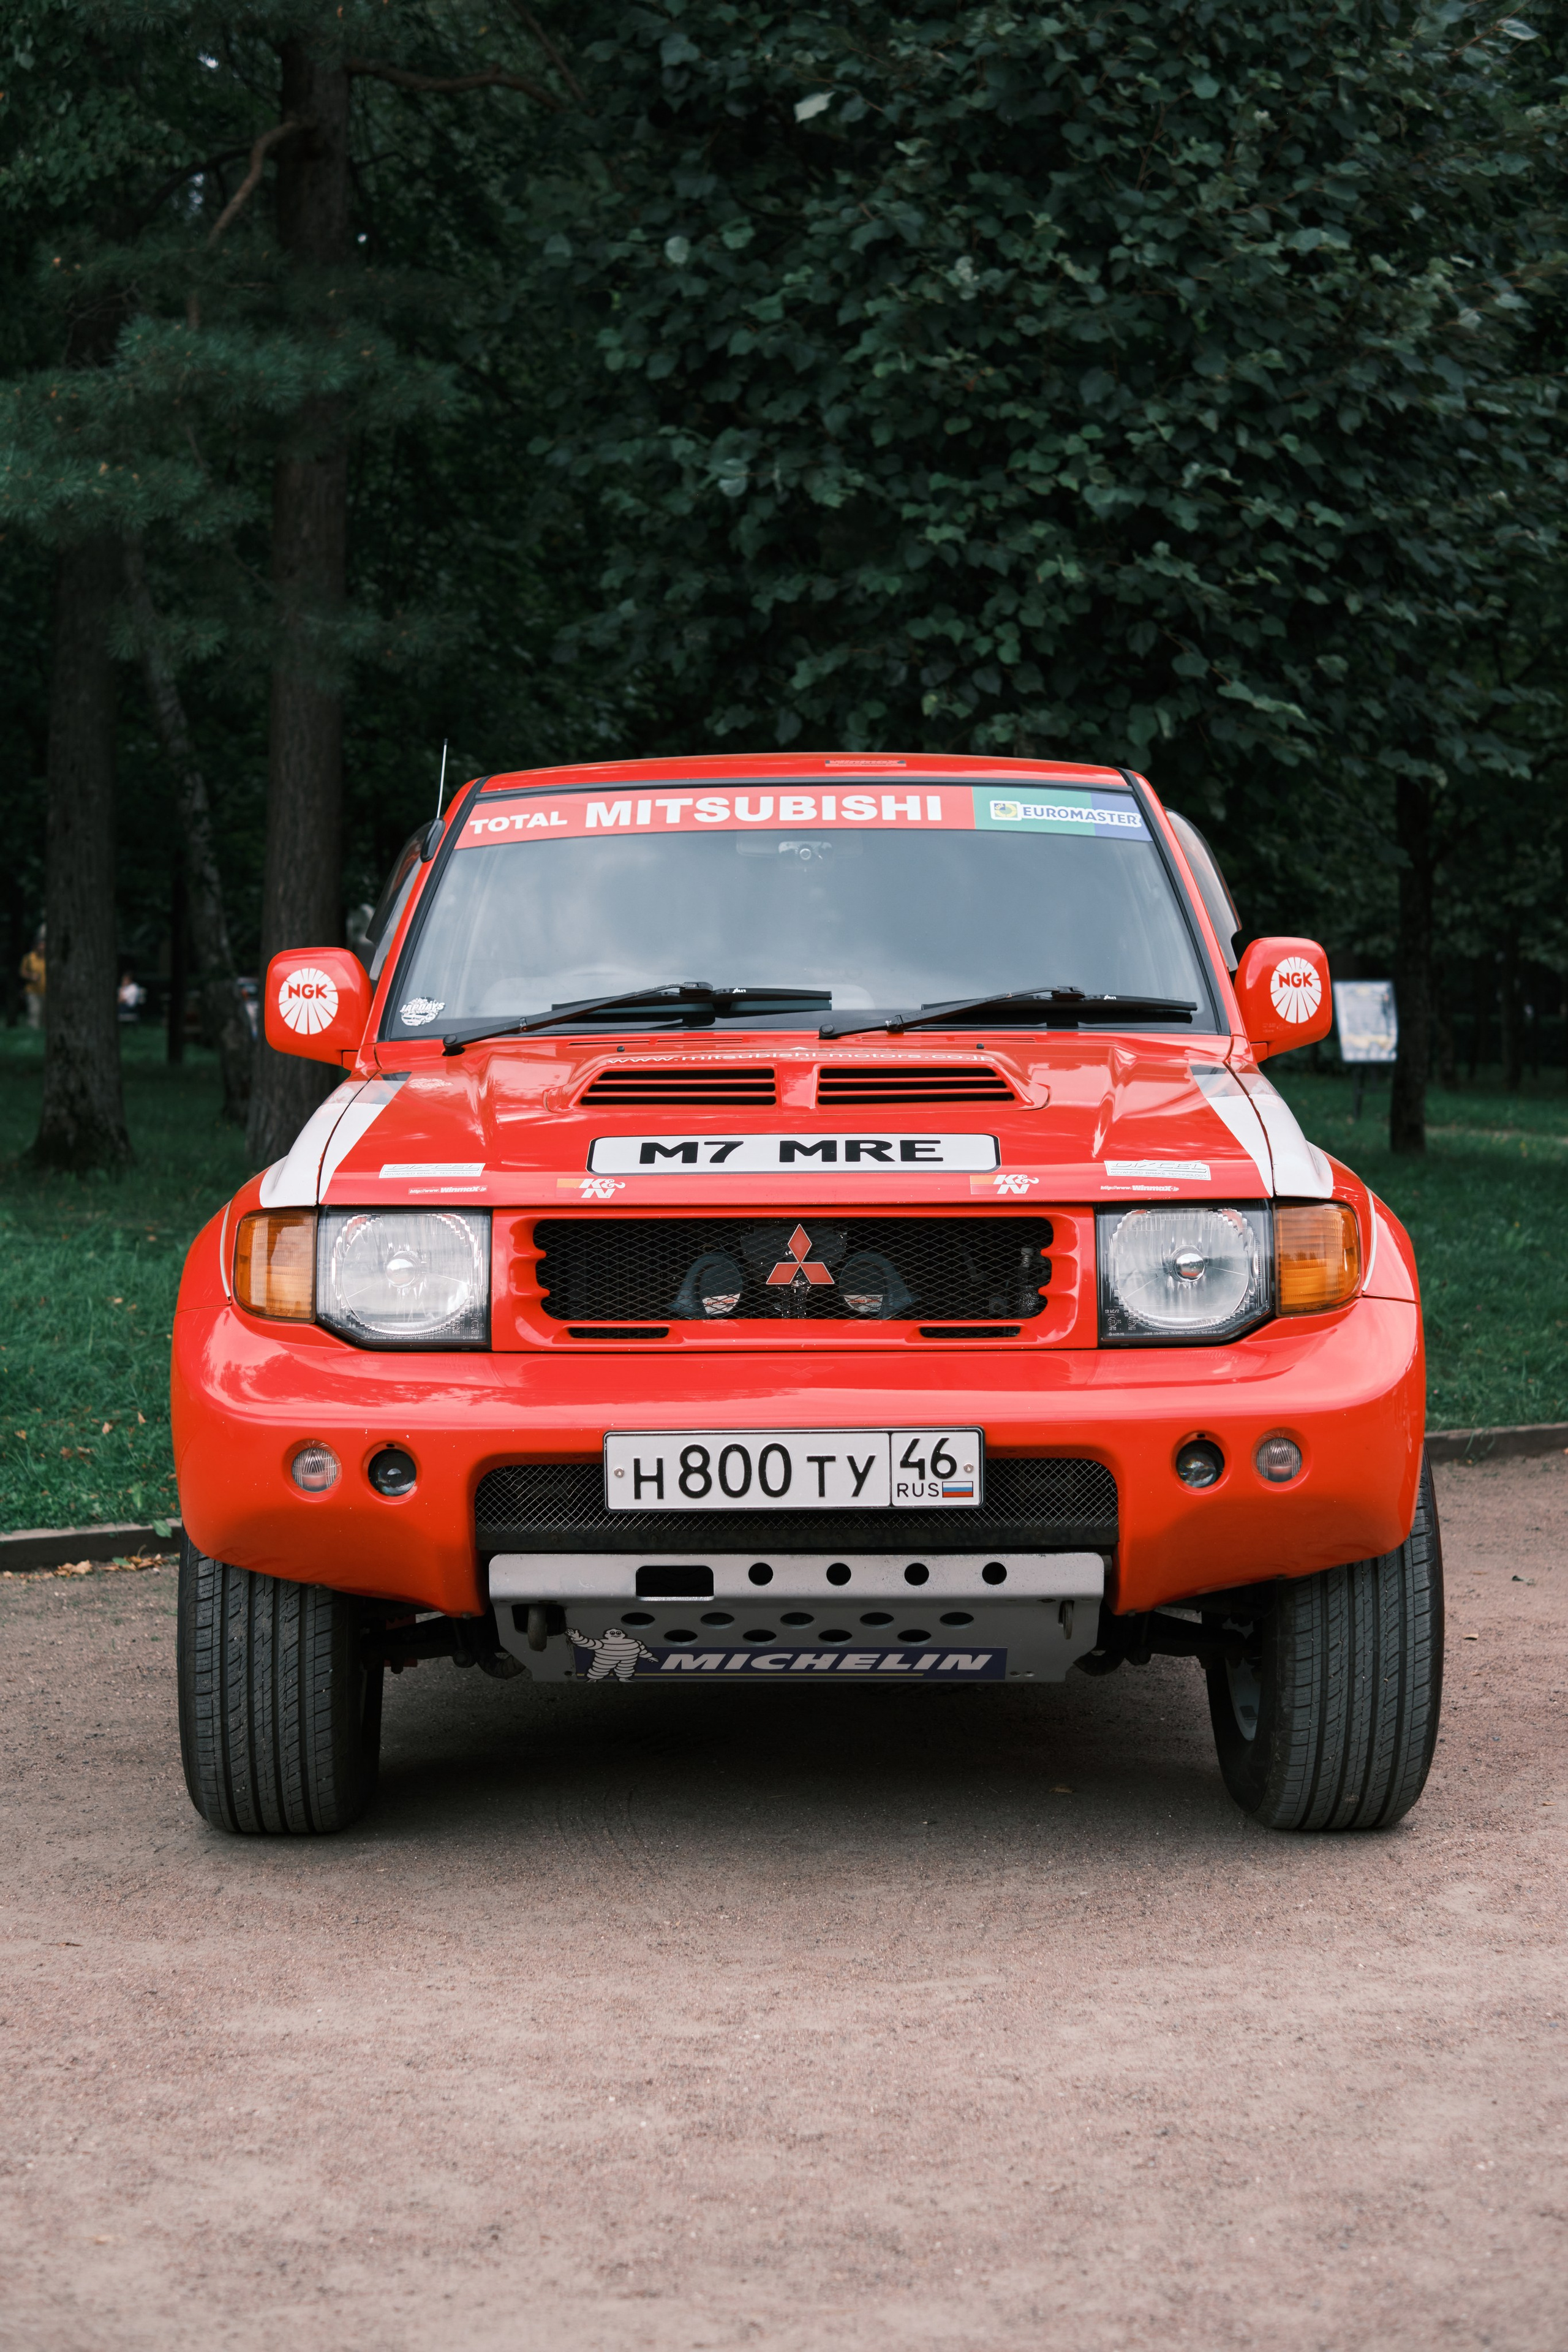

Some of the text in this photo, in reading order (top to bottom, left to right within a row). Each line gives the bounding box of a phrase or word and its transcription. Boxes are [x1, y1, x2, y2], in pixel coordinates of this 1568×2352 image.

[469, 795, 942, 834] TOTAL MITSUBISHI
[1022, 807, 1138, 825] EUROMASTER
[1278, 972, 1313, 988] NGK
[288, 984, 327, 999] NGK
[608, 1052, 996, 1063] www.mitsubishi-motors.co.jp
[639, 1140, 944, 1164] M7 MRE
[900, 1437, 957, 1480] 46
[897, 1482, 940, 1498] RUS
[660, 1654, 993, 1670] MICHELIN
